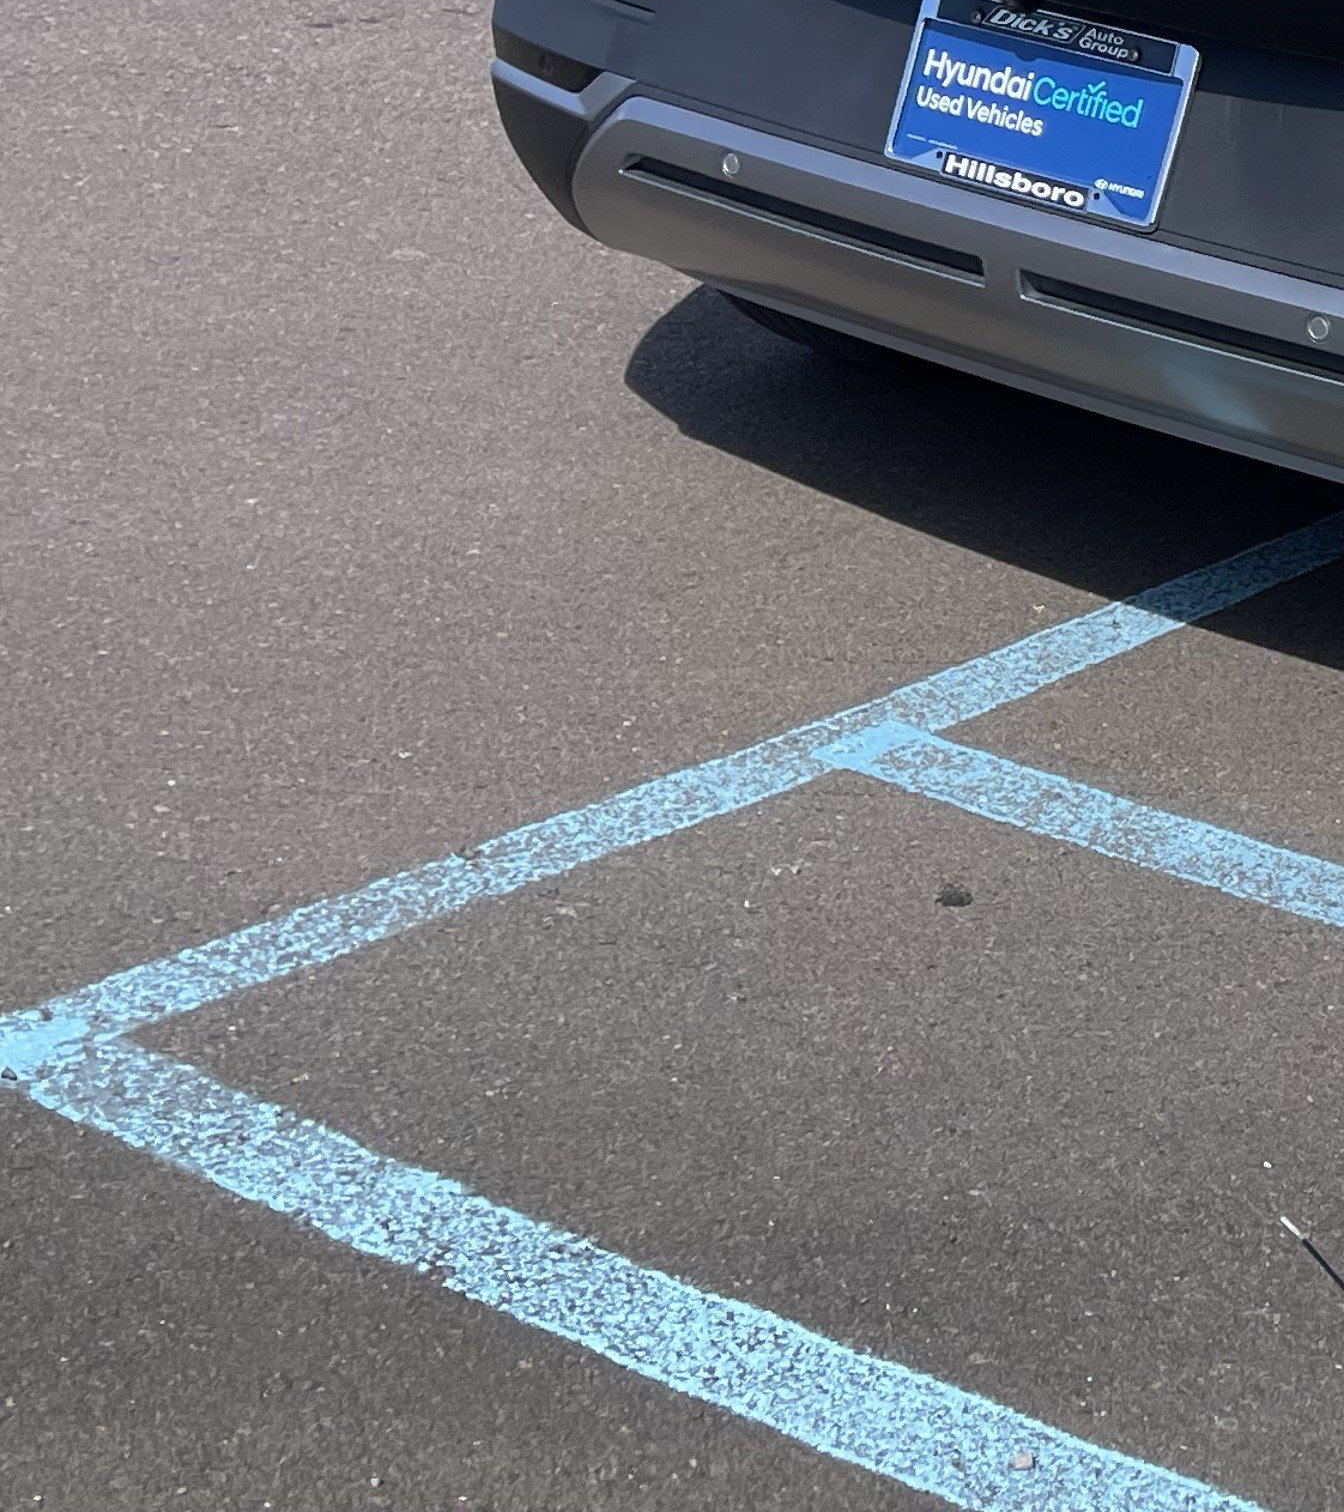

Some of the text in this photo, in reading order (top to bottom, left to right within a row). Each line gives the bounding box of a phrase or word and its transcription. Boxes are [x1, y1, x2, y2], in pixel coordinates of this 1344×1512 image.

[990, 9, 1073, 39] Dick's
[1084, 28, 1124, 46] Auto
[1079, 38, 1129, 59] Group
[923, 48, 1144, 128] Hyundai Certified
[916, 86, 1045, 138] Used Vehicles
[945, 154, 1085, 207] Hillsboro
